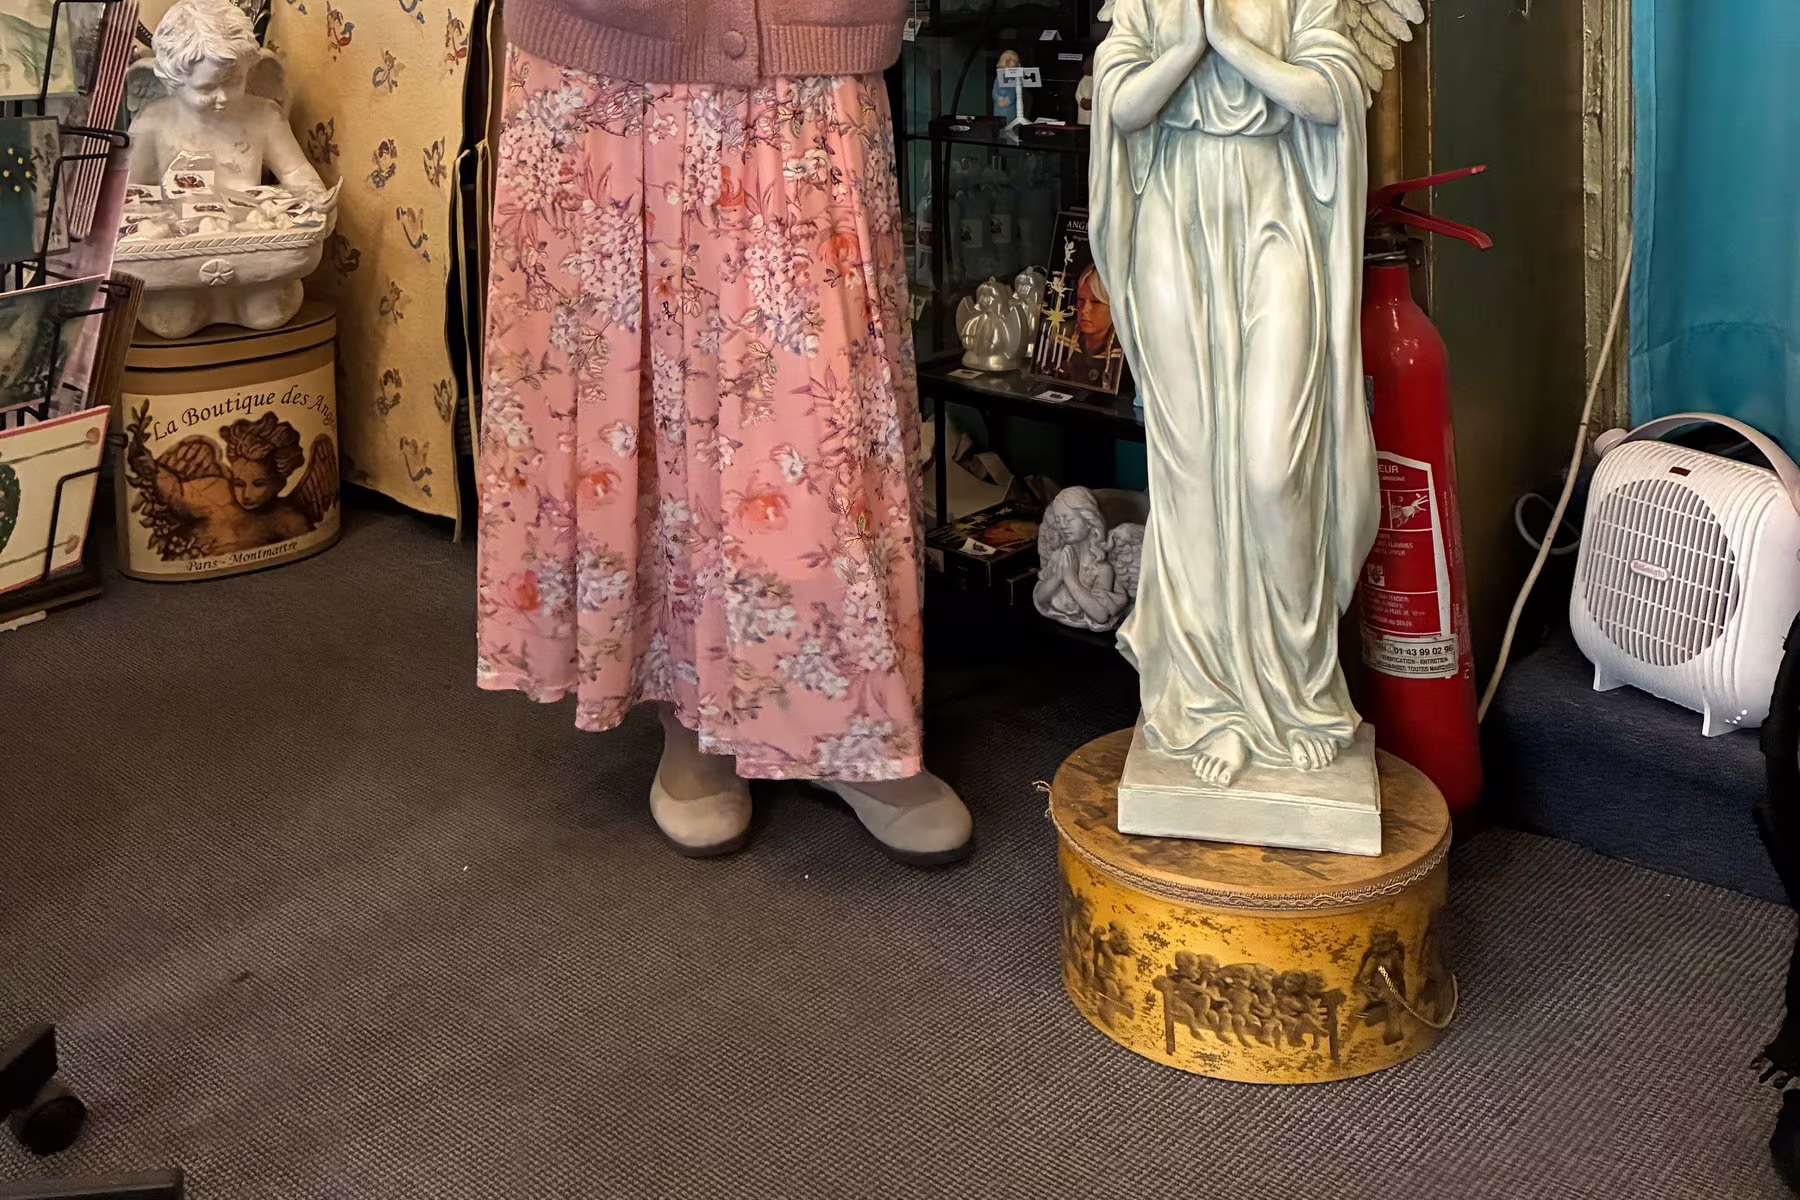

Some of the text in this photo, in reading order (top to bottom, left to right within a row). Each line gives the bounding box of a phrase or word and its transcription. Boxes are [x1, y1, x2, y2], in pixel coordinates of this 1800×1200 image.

[154, 420, 178, 441] La
[182, 392, 275, 426] Boutique
[280, 385, 310, 406] des
[187, 558, 218, 571] Paris
[229, 541, 298, 564] Montmartre
[1393, 647, 1403, 655] 01
[1406, 647, 1417, 656] 43
[1420, 647, 1430, 656] 99
[1432, 647, 1442, 655] 02
